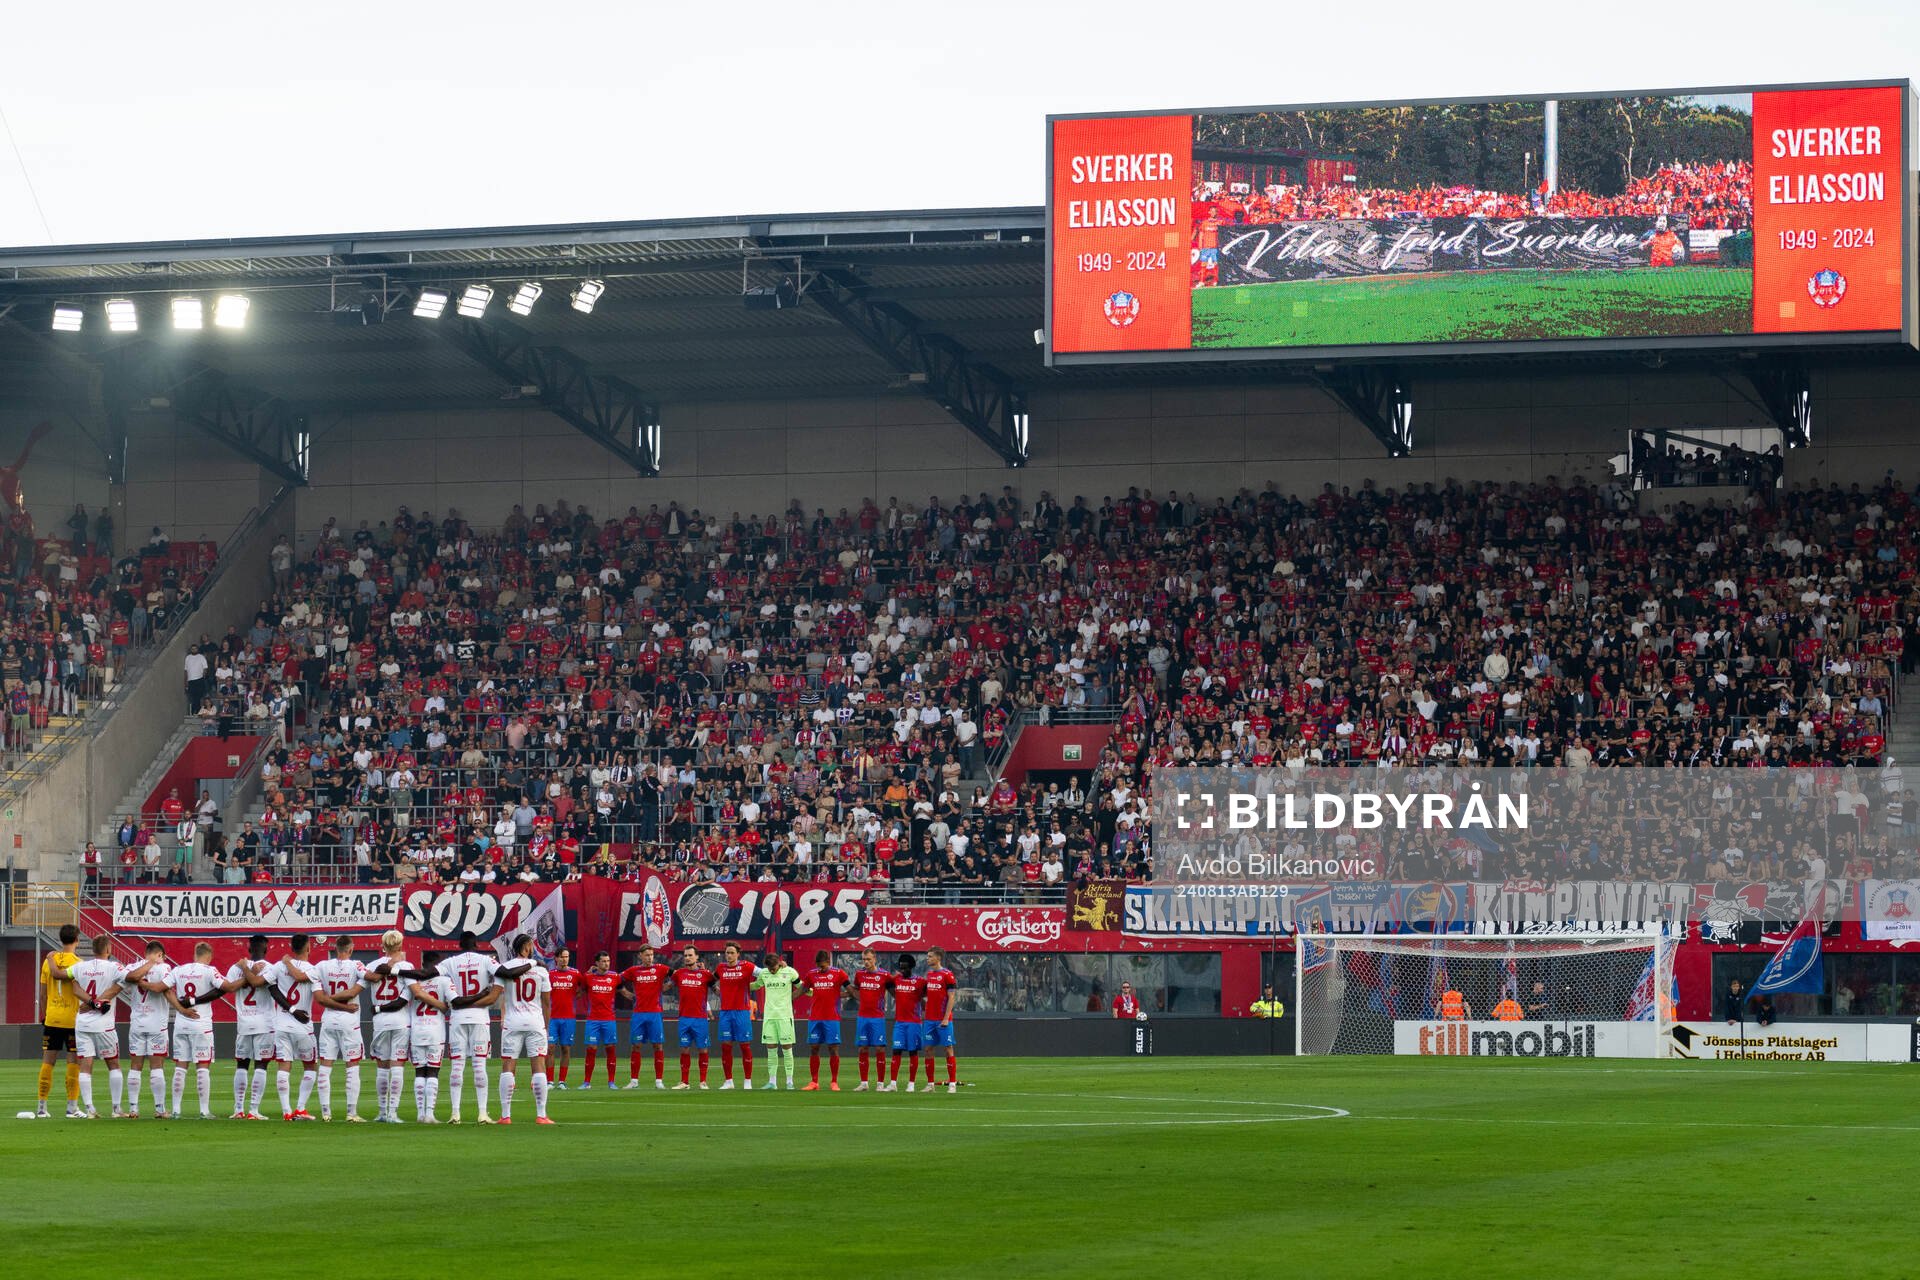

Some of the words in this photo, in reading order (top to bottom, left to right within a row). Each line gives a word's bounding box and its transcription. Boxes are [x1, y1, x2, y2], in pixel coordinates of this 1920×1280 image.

[1771, 125, 1882, 158] SVERKER
[1071, 152, 1174, 183] SVERKER
[1769, 171, 1884, 204] ELIASSON
[1068, 197, 1176, 229] ELIASSON
[1221, 224, 1344, 271] Vila
[1380, 223, 1477, 271] frid
[1778, 229, 1817, 250] 1949
[1832, 228, 1875, 249] 2024
[1076, 252, 1112, 272] 1949
[1126, 250, 1167, 271] 2024
[120, 891, 257, 917] AVSTÄNGDA
[306, 892, 397, 916] HIF:ARE
[737, 888, 865, 936] 1985
[1474, 882, 1692, 936] KOMPANIET
[862, 912, 922, 941] rlsberg
[976, 910, 1062, 943] Carlsberg
[86, 980, 97, 1002] 4
[184, 982, 196, 999] 8
[242, 982, 256, 1006] 2
[287, 981, 300, 1006] 6
[375, 975, 399, 1001] 23
[458, 970, 480, 997] 15
[513, 978, 536, 1002] 10
[1418, 1024, 1595, 1057] tillmobil
[1703, 1036, 1764, 1047] Jönssons
[1767, 1036, 1838, 1050] Plåtslageri
[1716, 1050, 1720, 1060] i
[1806, 1051, 1825, 1061] AB
